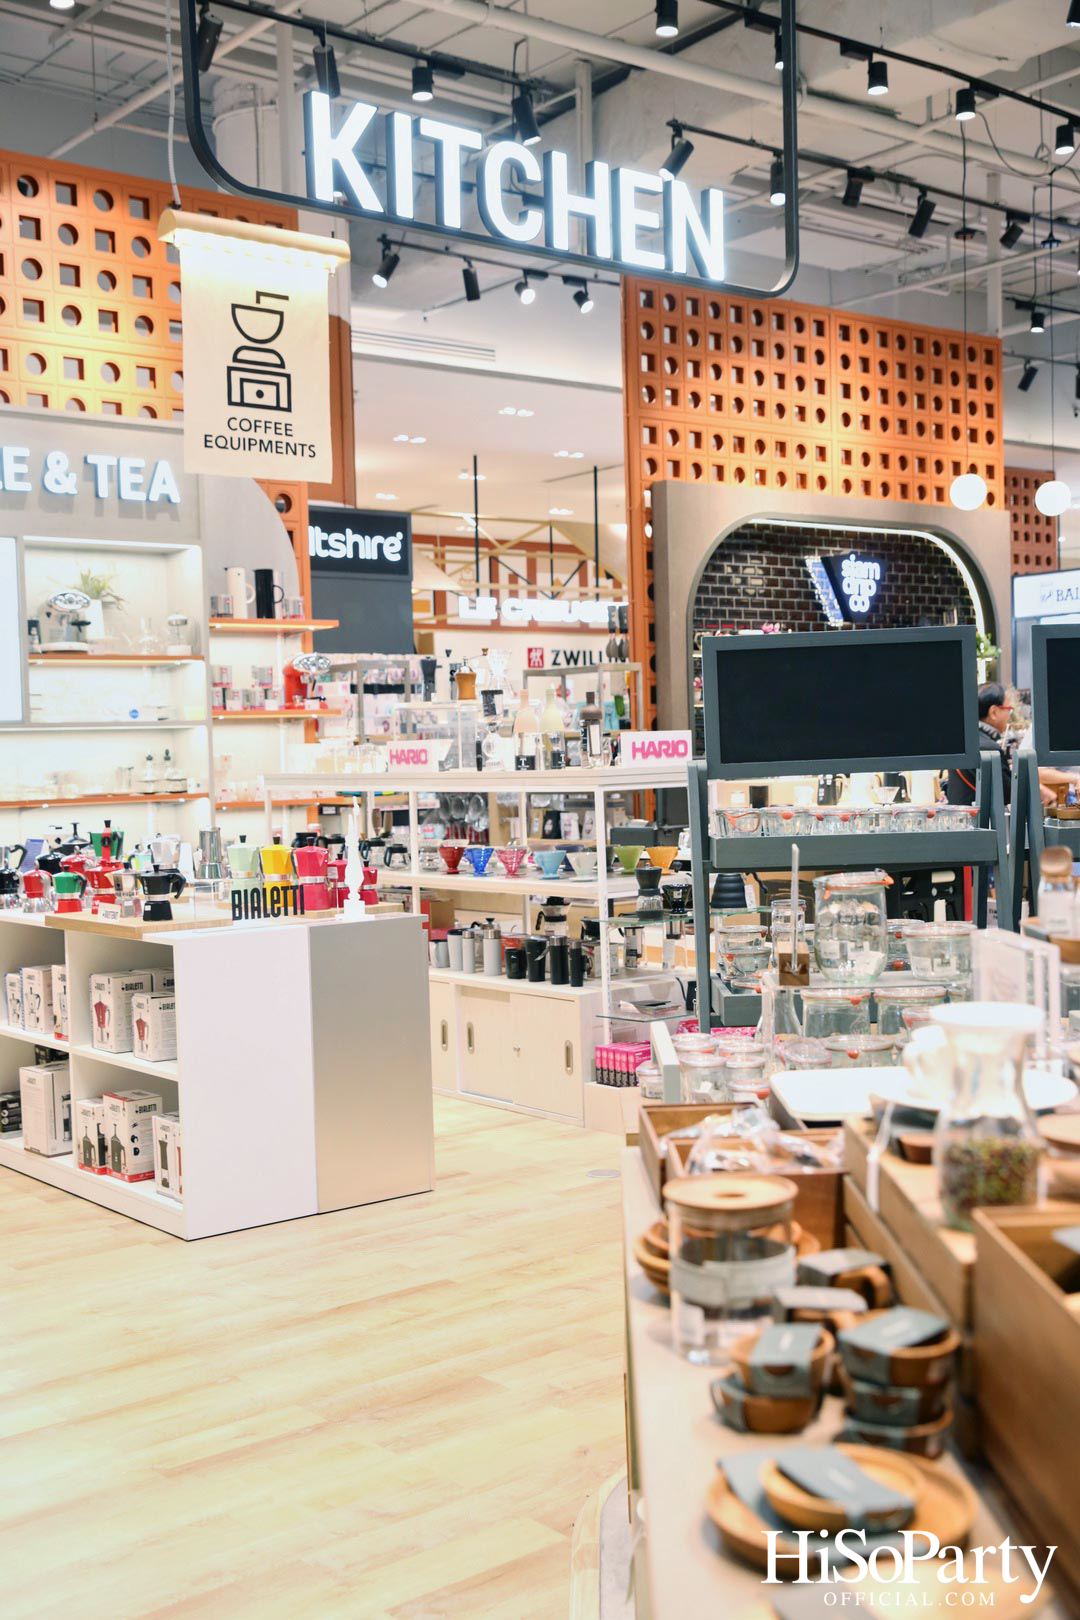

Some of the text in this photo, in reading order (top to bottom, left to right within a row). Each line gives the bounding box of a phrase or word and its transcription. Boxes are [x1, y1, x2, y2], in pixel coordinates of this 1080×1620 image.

[303, 91, 725, 281] KITCHEN
[227, 416, 294, 437] COFFEE
[203, 434, 317, 459] EQUIPMENTS
[0, 446, 181, 503] E & TEA
[389, 747, 428, 765] HARIO
[631, 738, 689, 761] HARIO
